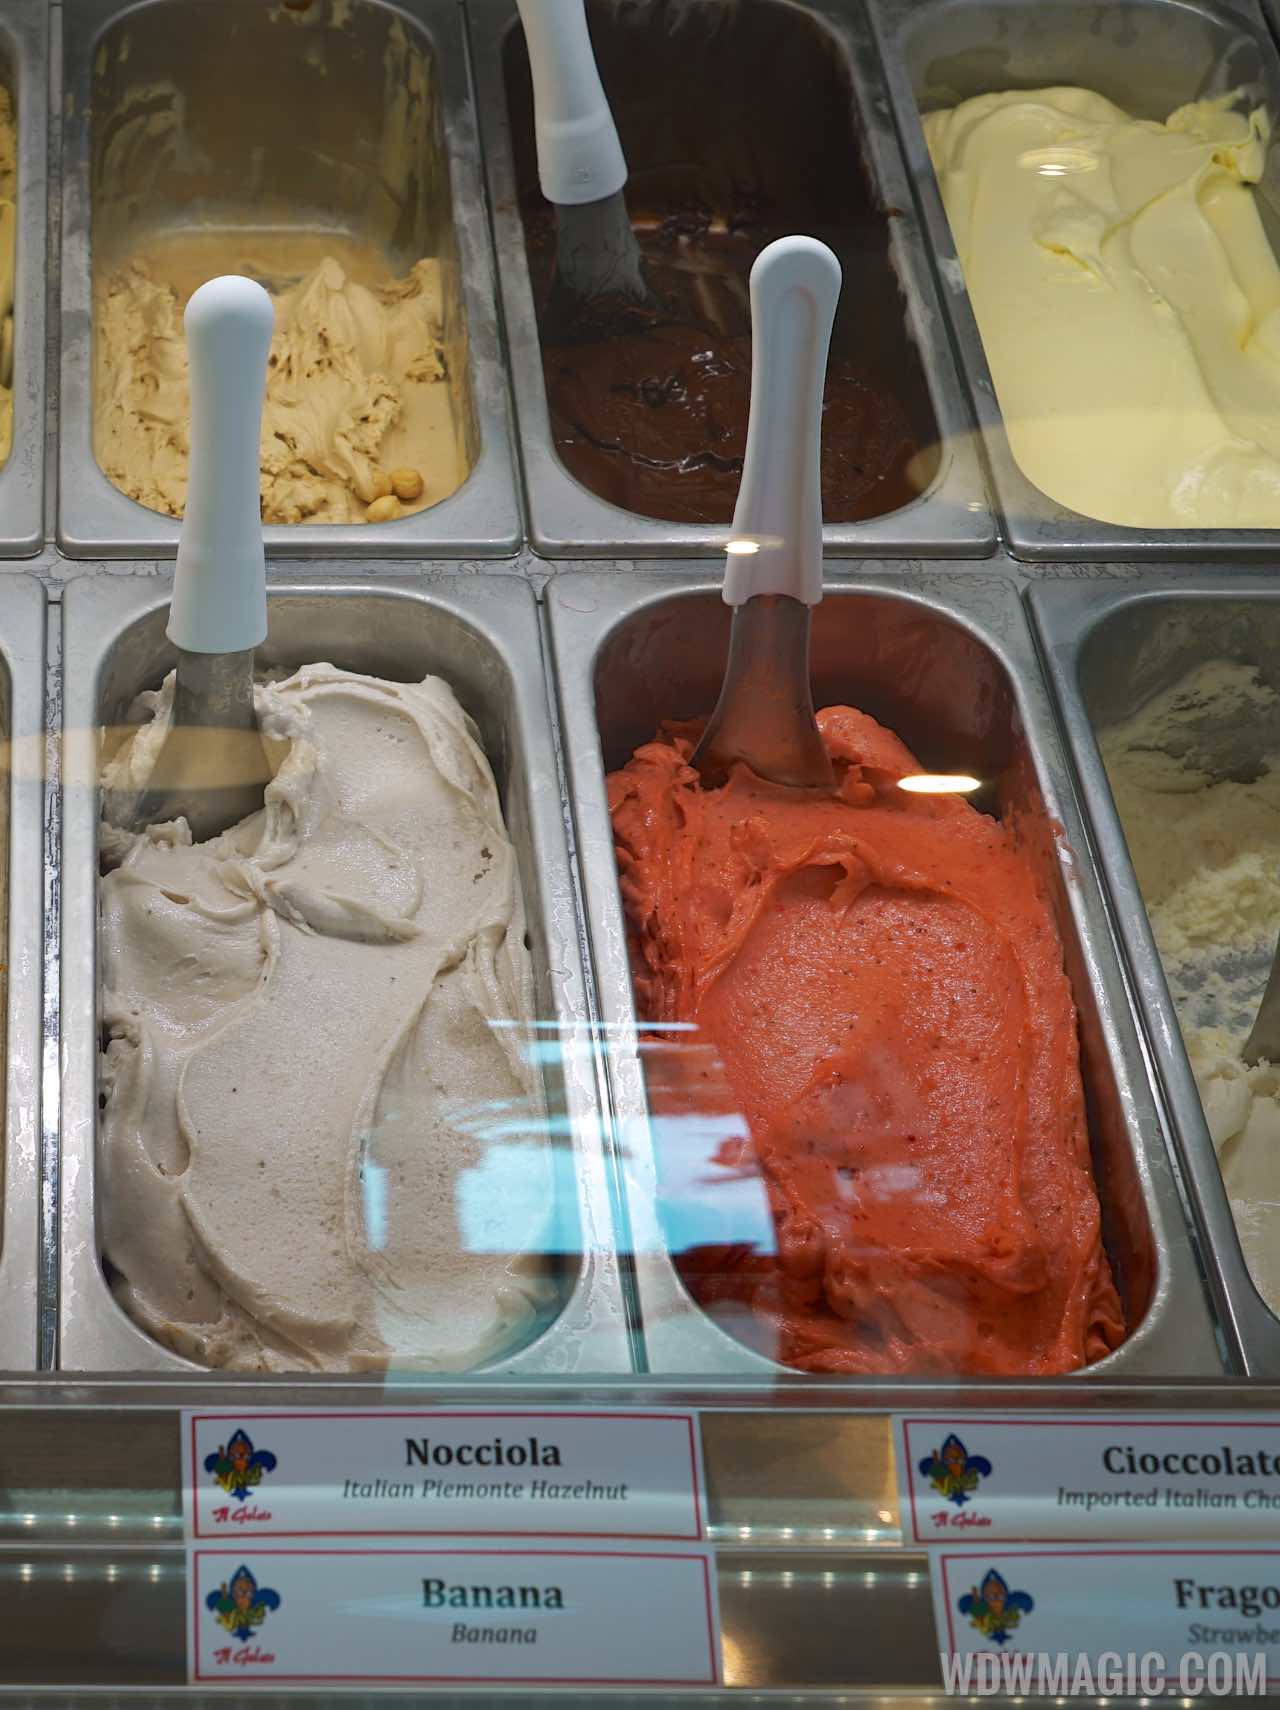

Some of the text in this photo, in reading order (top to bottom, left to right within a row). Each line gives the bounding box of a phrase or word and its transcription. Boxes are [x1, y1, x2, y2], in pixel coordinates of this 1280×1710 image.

[404, 1437, 562, 1468] Nocciola
[342, 1478, 629, 1502] Italian Piemonte Hazelnut
[1057, 1486, 1158, 1512] Imported
[1165, 1487, 1237, 1509] Italian
[421, 1577, 565, 1610] Banana
[1173, 1578, 1280, 1618] Frago
[450, 1622, 538, 1645] Banana
